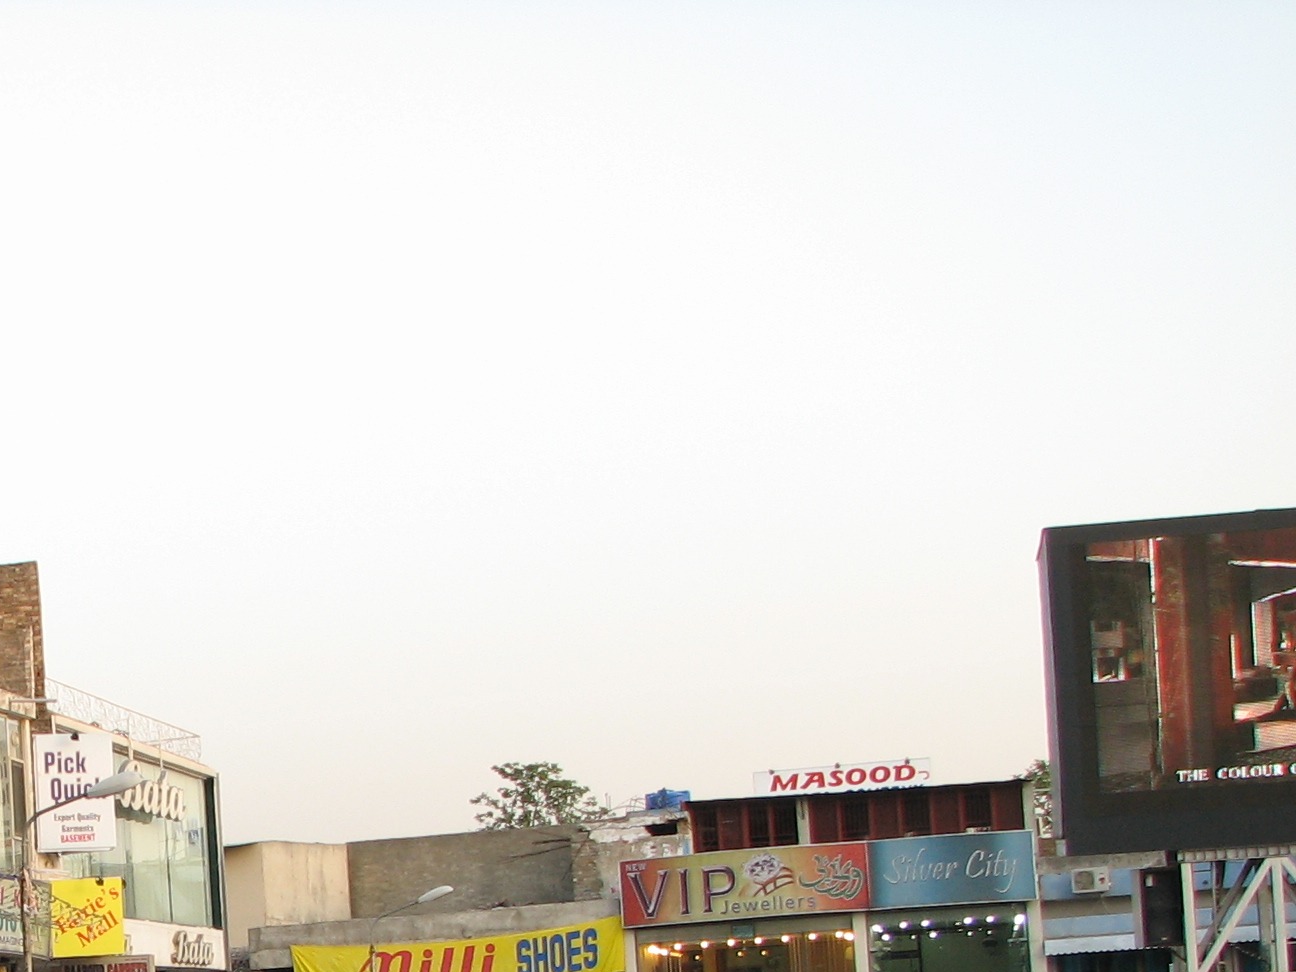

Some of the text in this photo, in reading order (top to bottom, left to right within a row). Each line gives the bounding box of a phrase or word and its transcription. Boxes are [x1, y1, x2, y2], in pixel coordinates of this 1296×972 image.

[44, 752, 87, 774] Pick
[1176, 768, 1210, 783] THE
[1216, 763, 1284, 780] COLOUR
[50, 777, 106, 806] Quic
[770, 764, 916, 793] MASOOD
[883, 848, 1018, 893] Silver City
[626, 864, 737, 919] VIP
[720, 895, 817, 915] Jewellers
[76, 910, 120, 949] Mall
[170, 930, 213, 966] Bata
